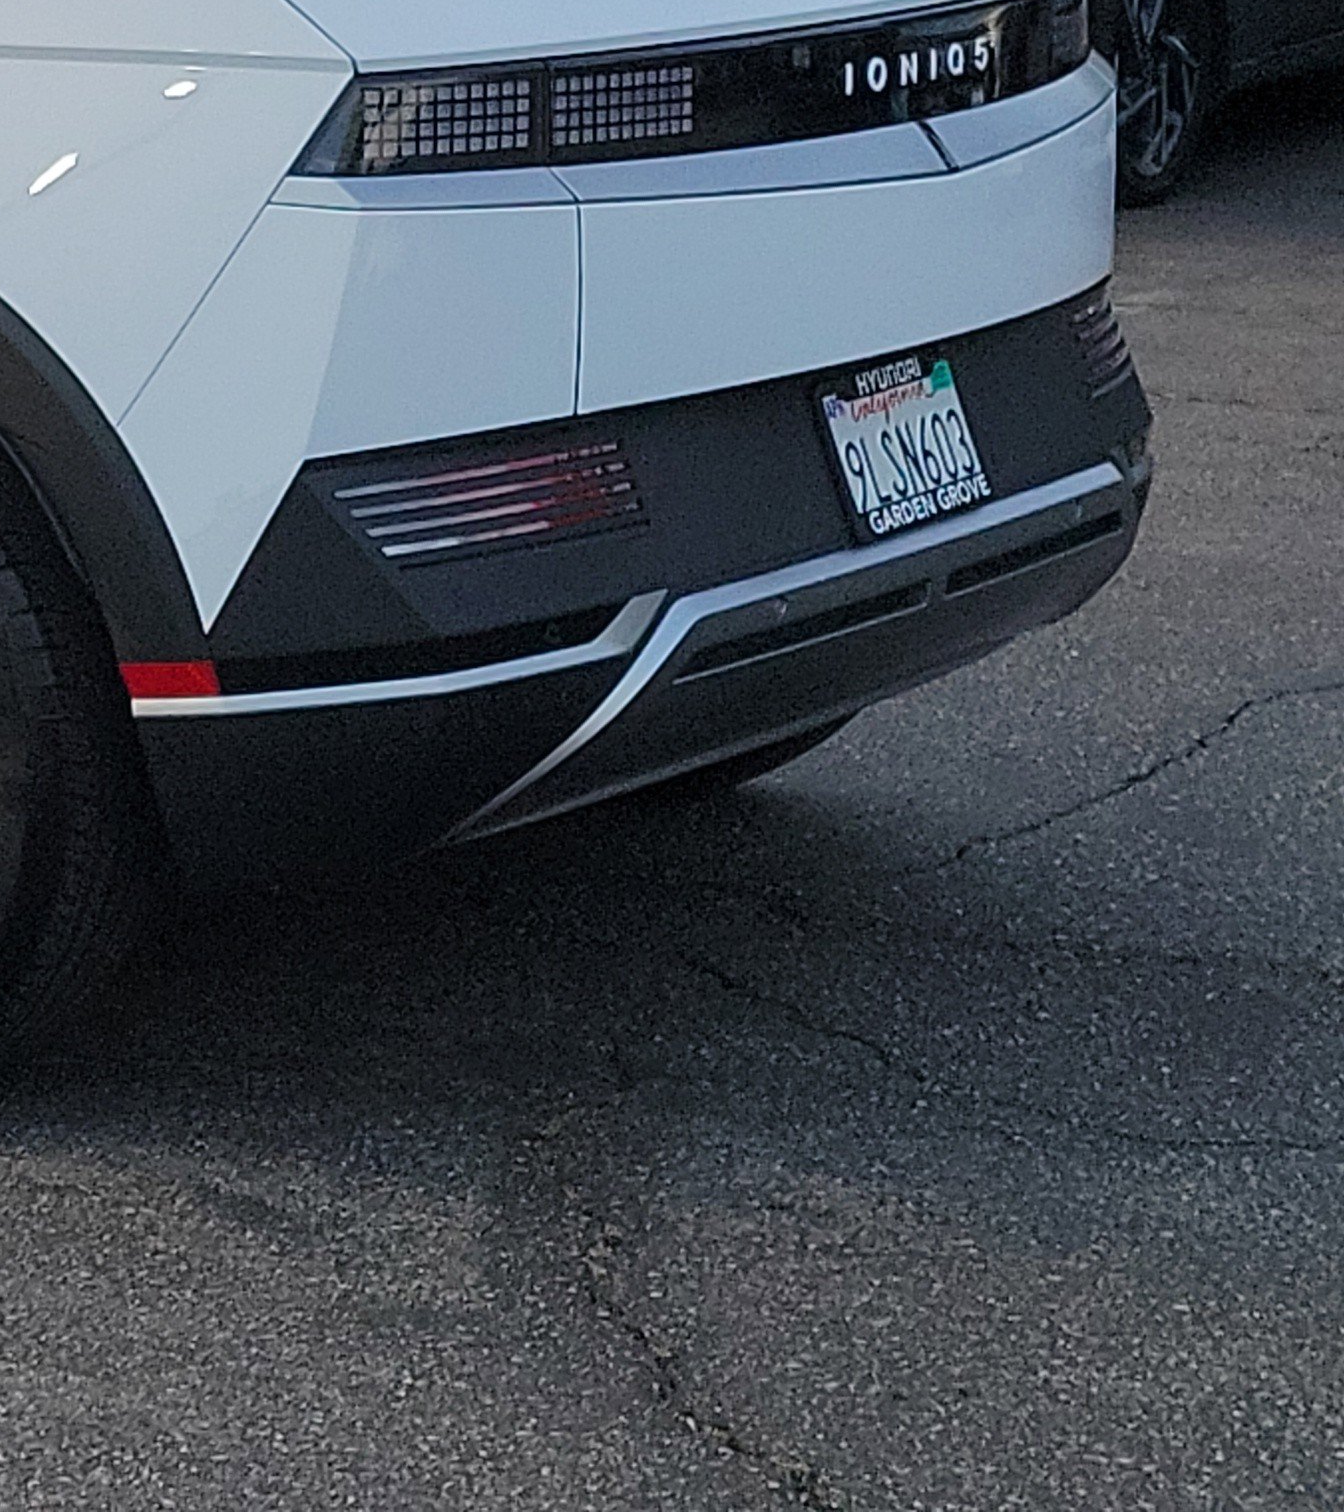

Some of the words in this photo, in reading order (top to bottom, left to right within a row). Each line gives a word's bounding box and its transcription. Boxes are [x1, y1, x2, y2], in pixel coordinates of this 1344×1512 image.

[855, 357, 922, 395] HYUNDAI
[844, 407, 976, 510] 9LSN603
[867, 492, 938, 535] GARDEN
[935, 473, 993, 511] GROVE
